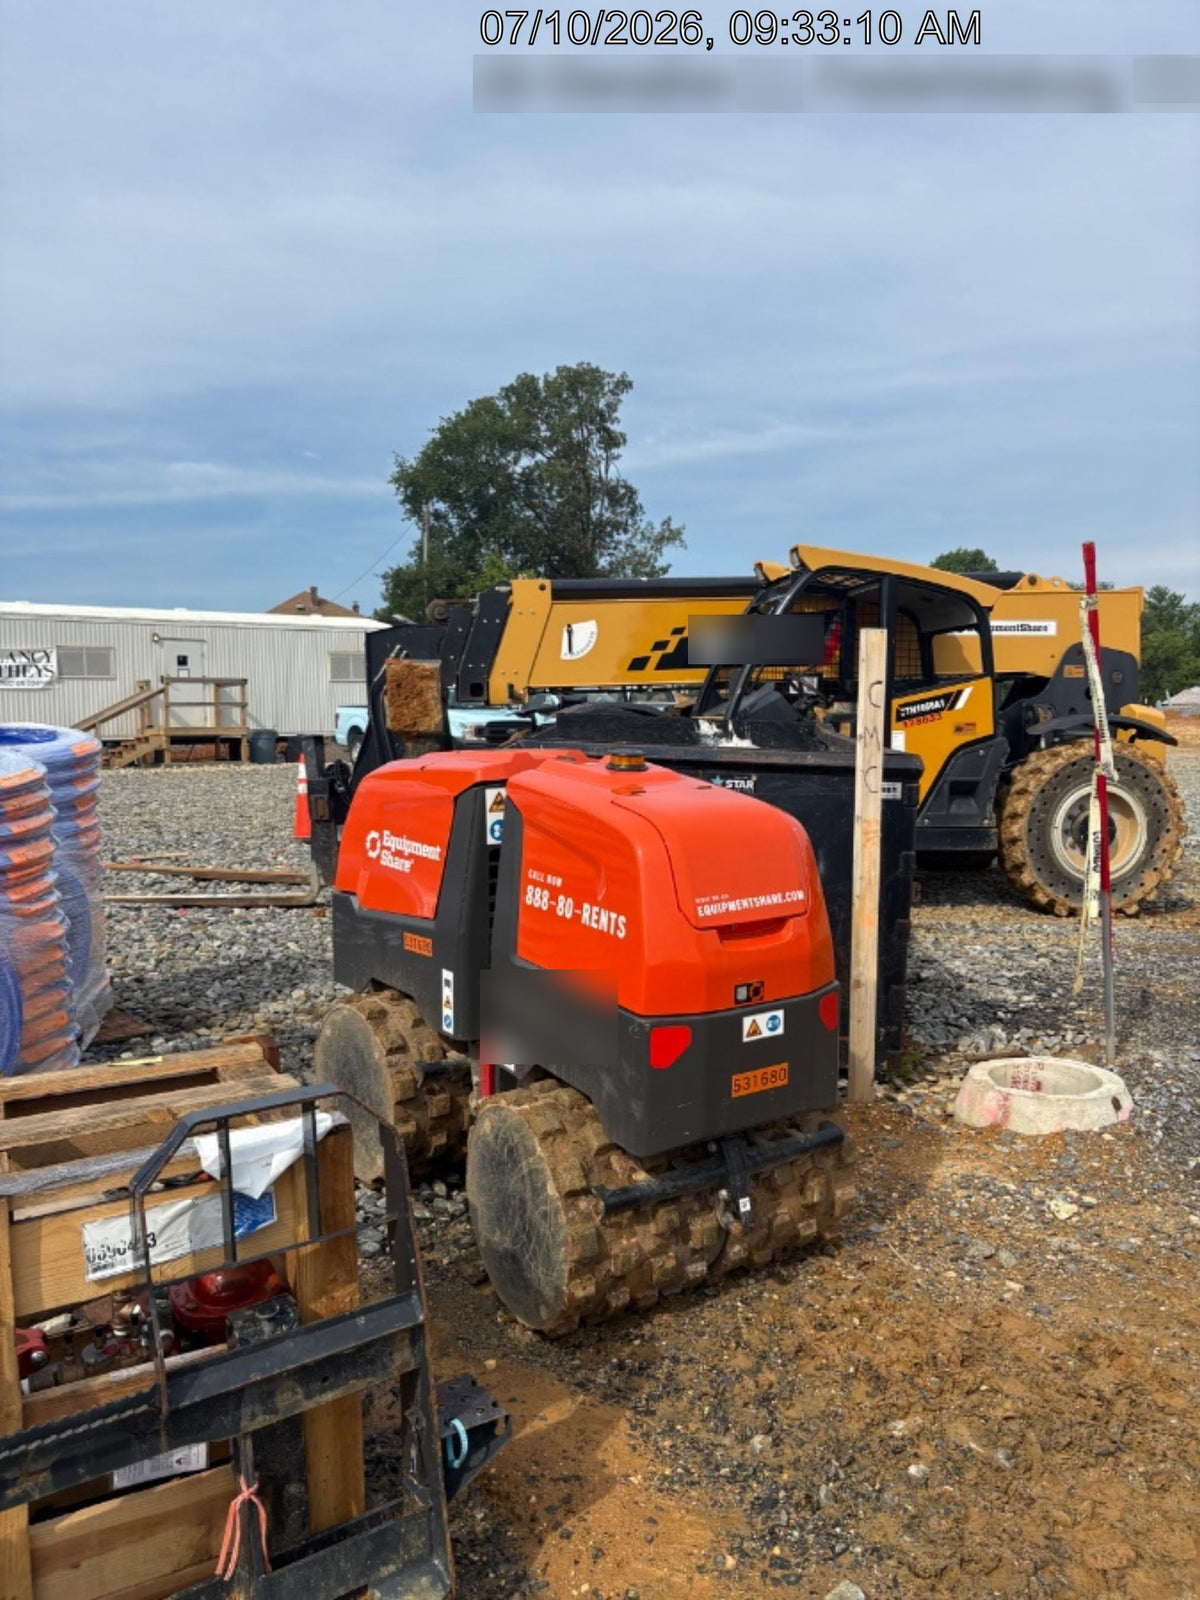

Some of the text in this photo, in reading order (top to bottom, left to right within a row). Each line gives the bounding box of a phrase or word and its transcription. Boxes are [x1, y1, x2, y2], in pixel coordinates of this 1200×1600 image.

[0, 650, 53, 663] ANCY
[725, 780, 755, 789] STAR
[382, 829, 442, 861] Equipment
[525, 884, 627, 938] 888-80-RENTS
[697, 890, 804, 916] EQUIPMENTSHARE.COM
[733, 1067, 787, 1093] 531680
